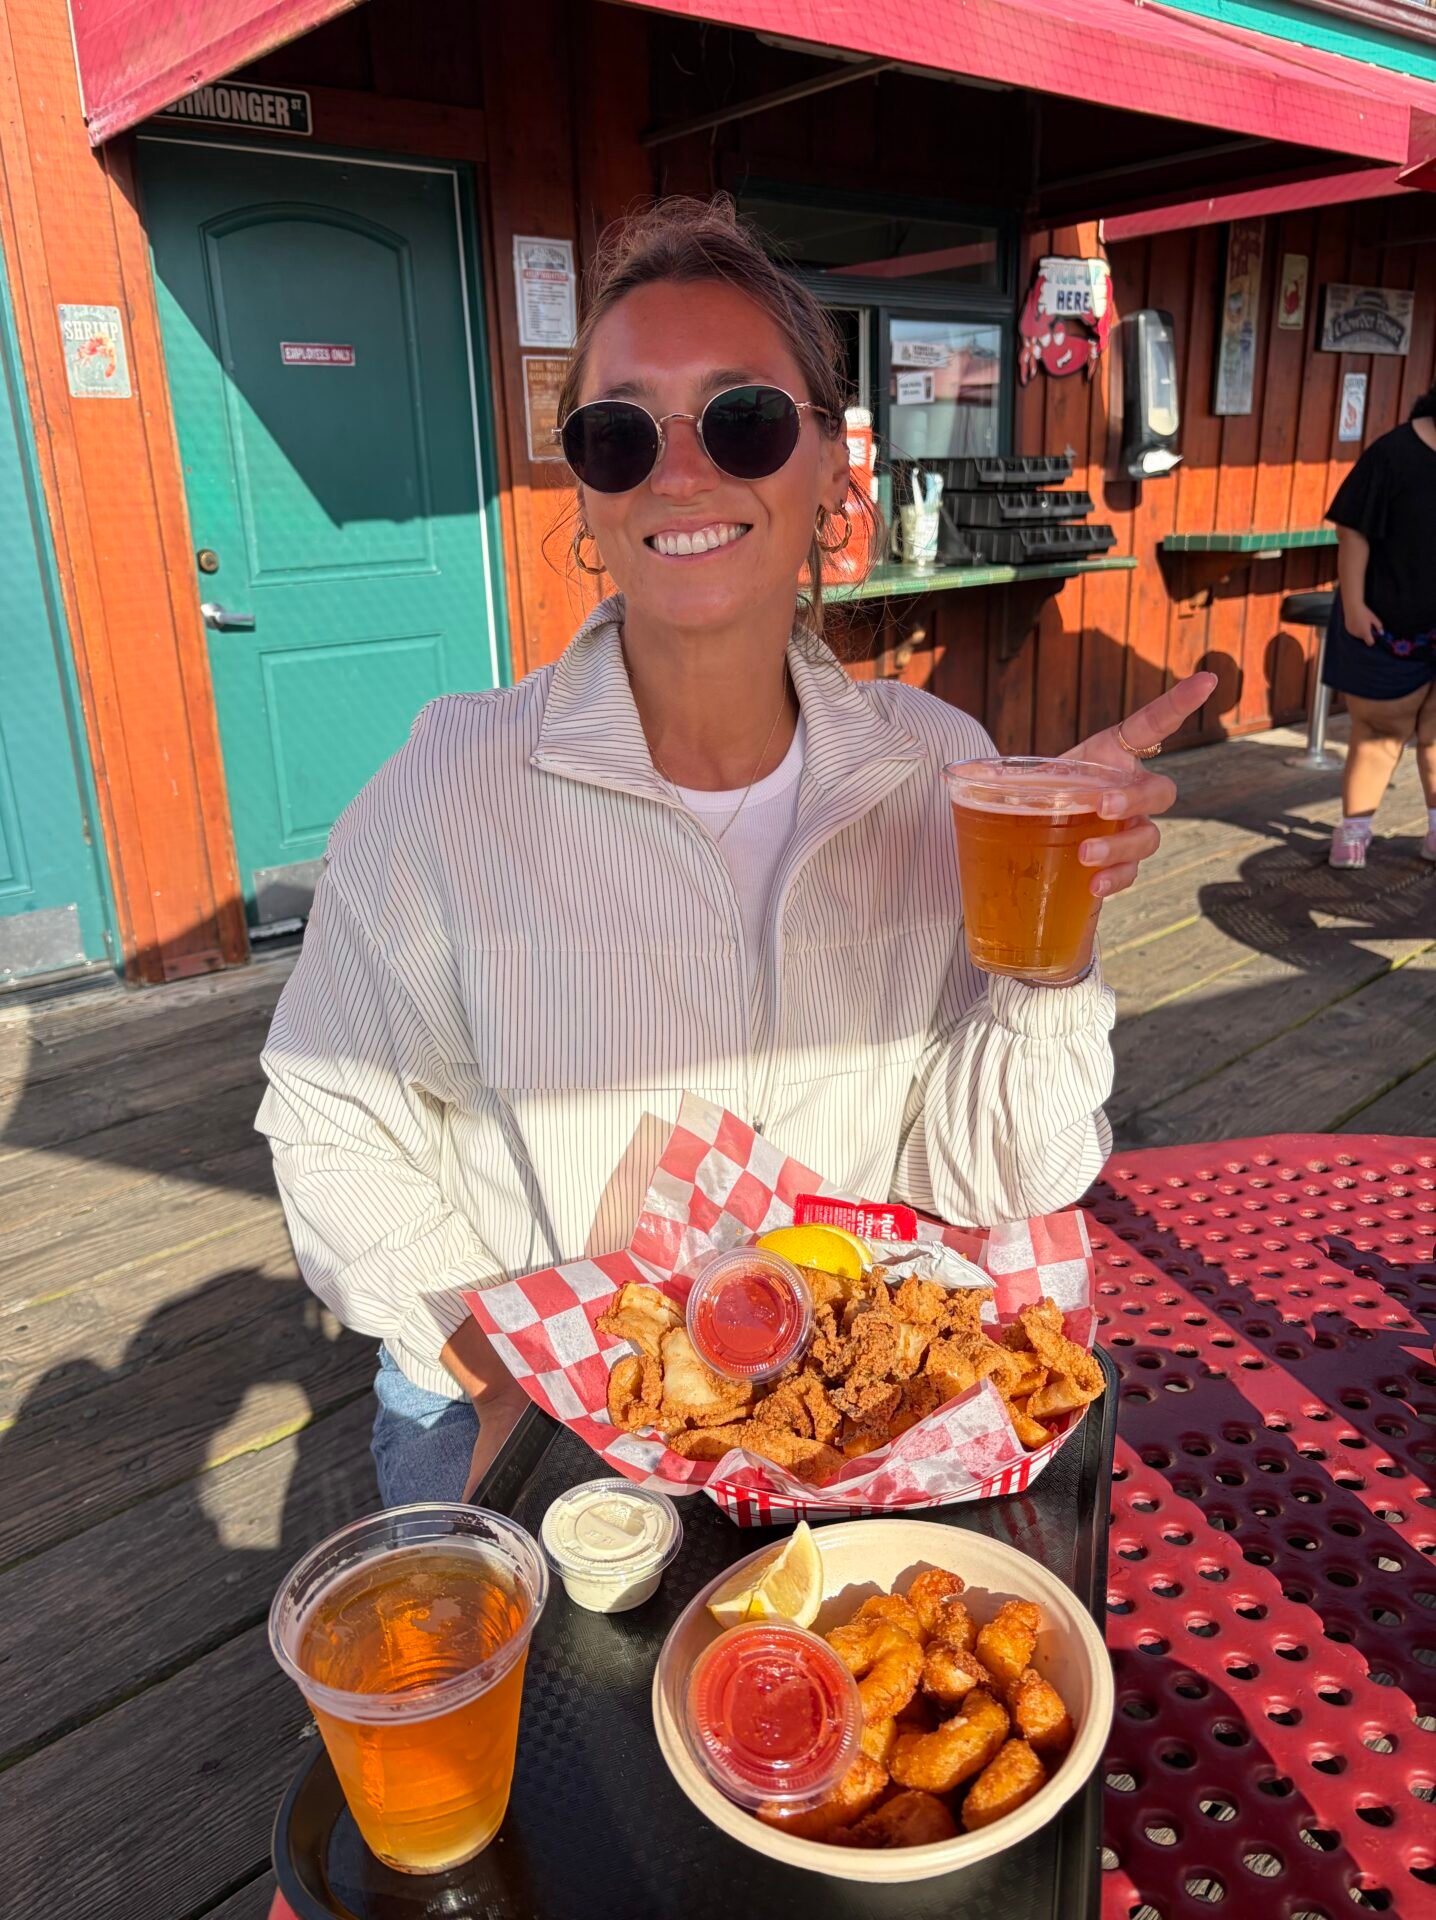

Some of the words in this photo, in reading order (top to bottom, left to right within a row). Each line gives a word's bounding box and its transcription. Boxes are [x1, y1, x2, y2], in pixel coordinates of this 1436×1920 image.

[290, 98, 302, 111] ST
[1056, 289, 1090, 312] HERE
[63, 320, 118, 342] SHRIMP
[284, 346, 331, 361] EMPLOYEES
[331, 348, 352, 361] ONLY
